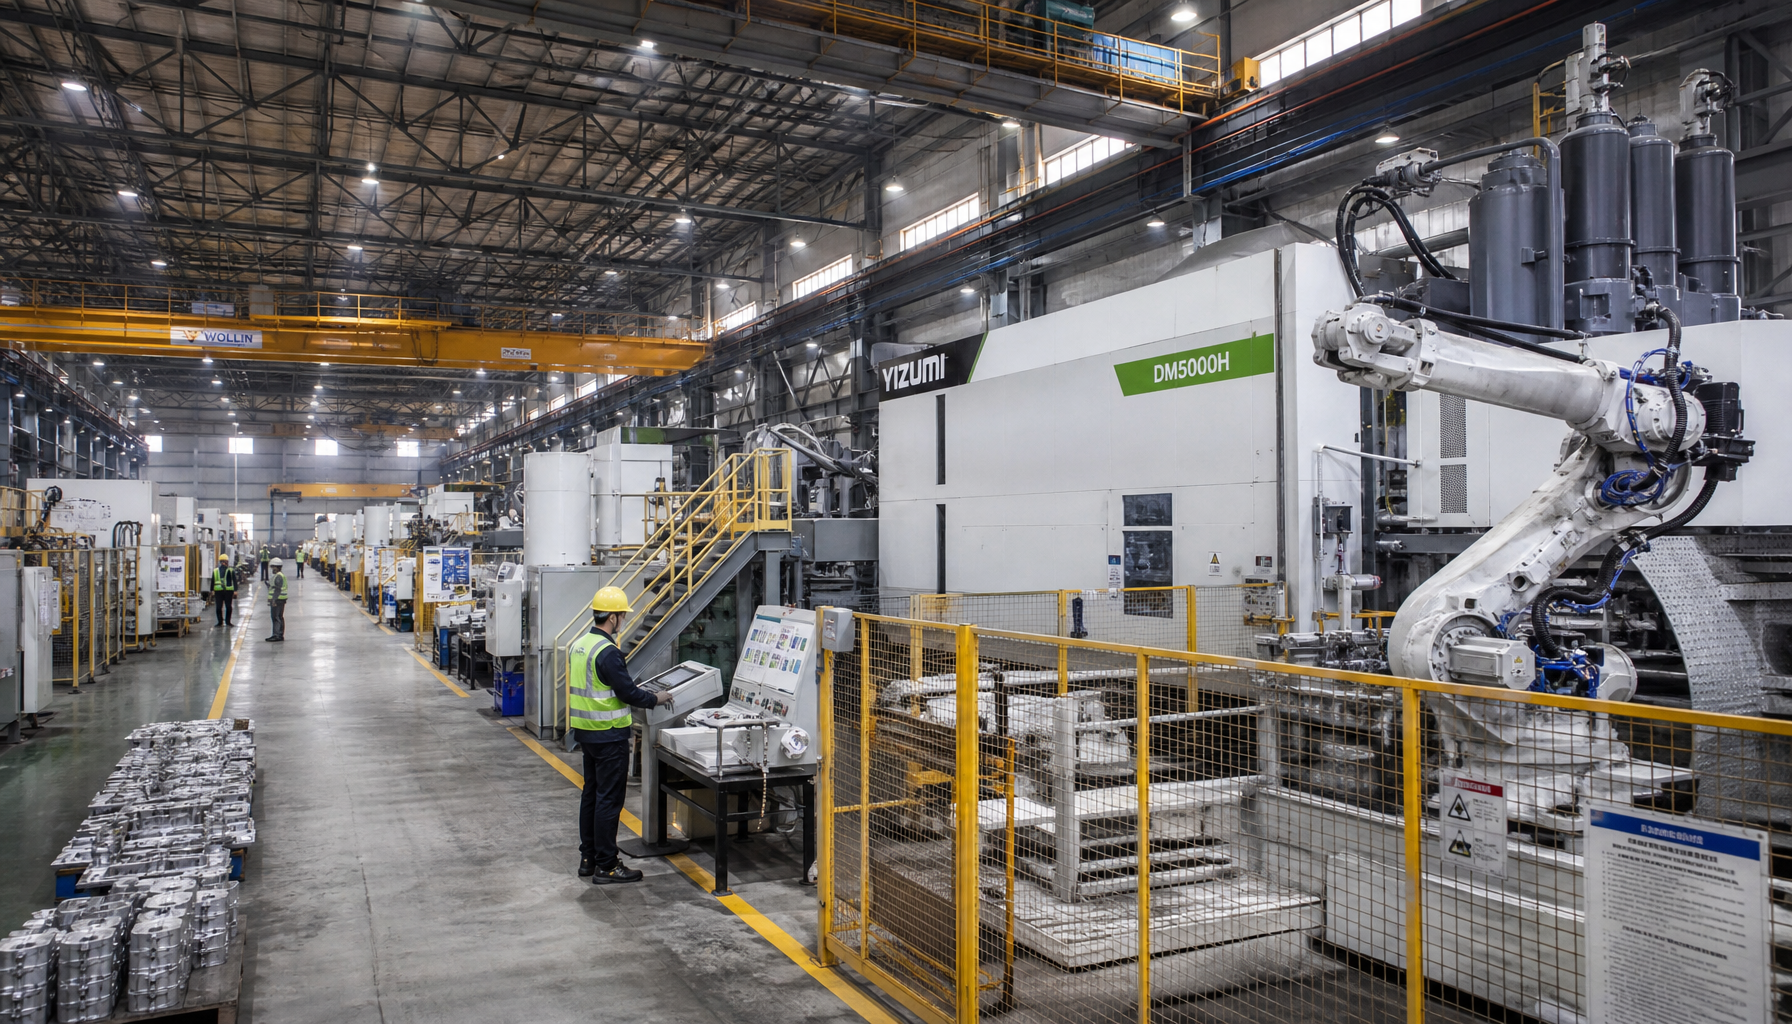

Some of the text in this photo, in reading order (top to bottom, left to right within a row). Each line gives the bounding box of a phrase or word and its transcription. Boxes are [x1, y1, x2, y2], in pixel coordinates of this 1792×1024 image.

[204, 332, 253, 343] WOLLIN
[882, 353, 945, 392] YIZUMI
[1154, 351, 1230, 383] DM5000H
